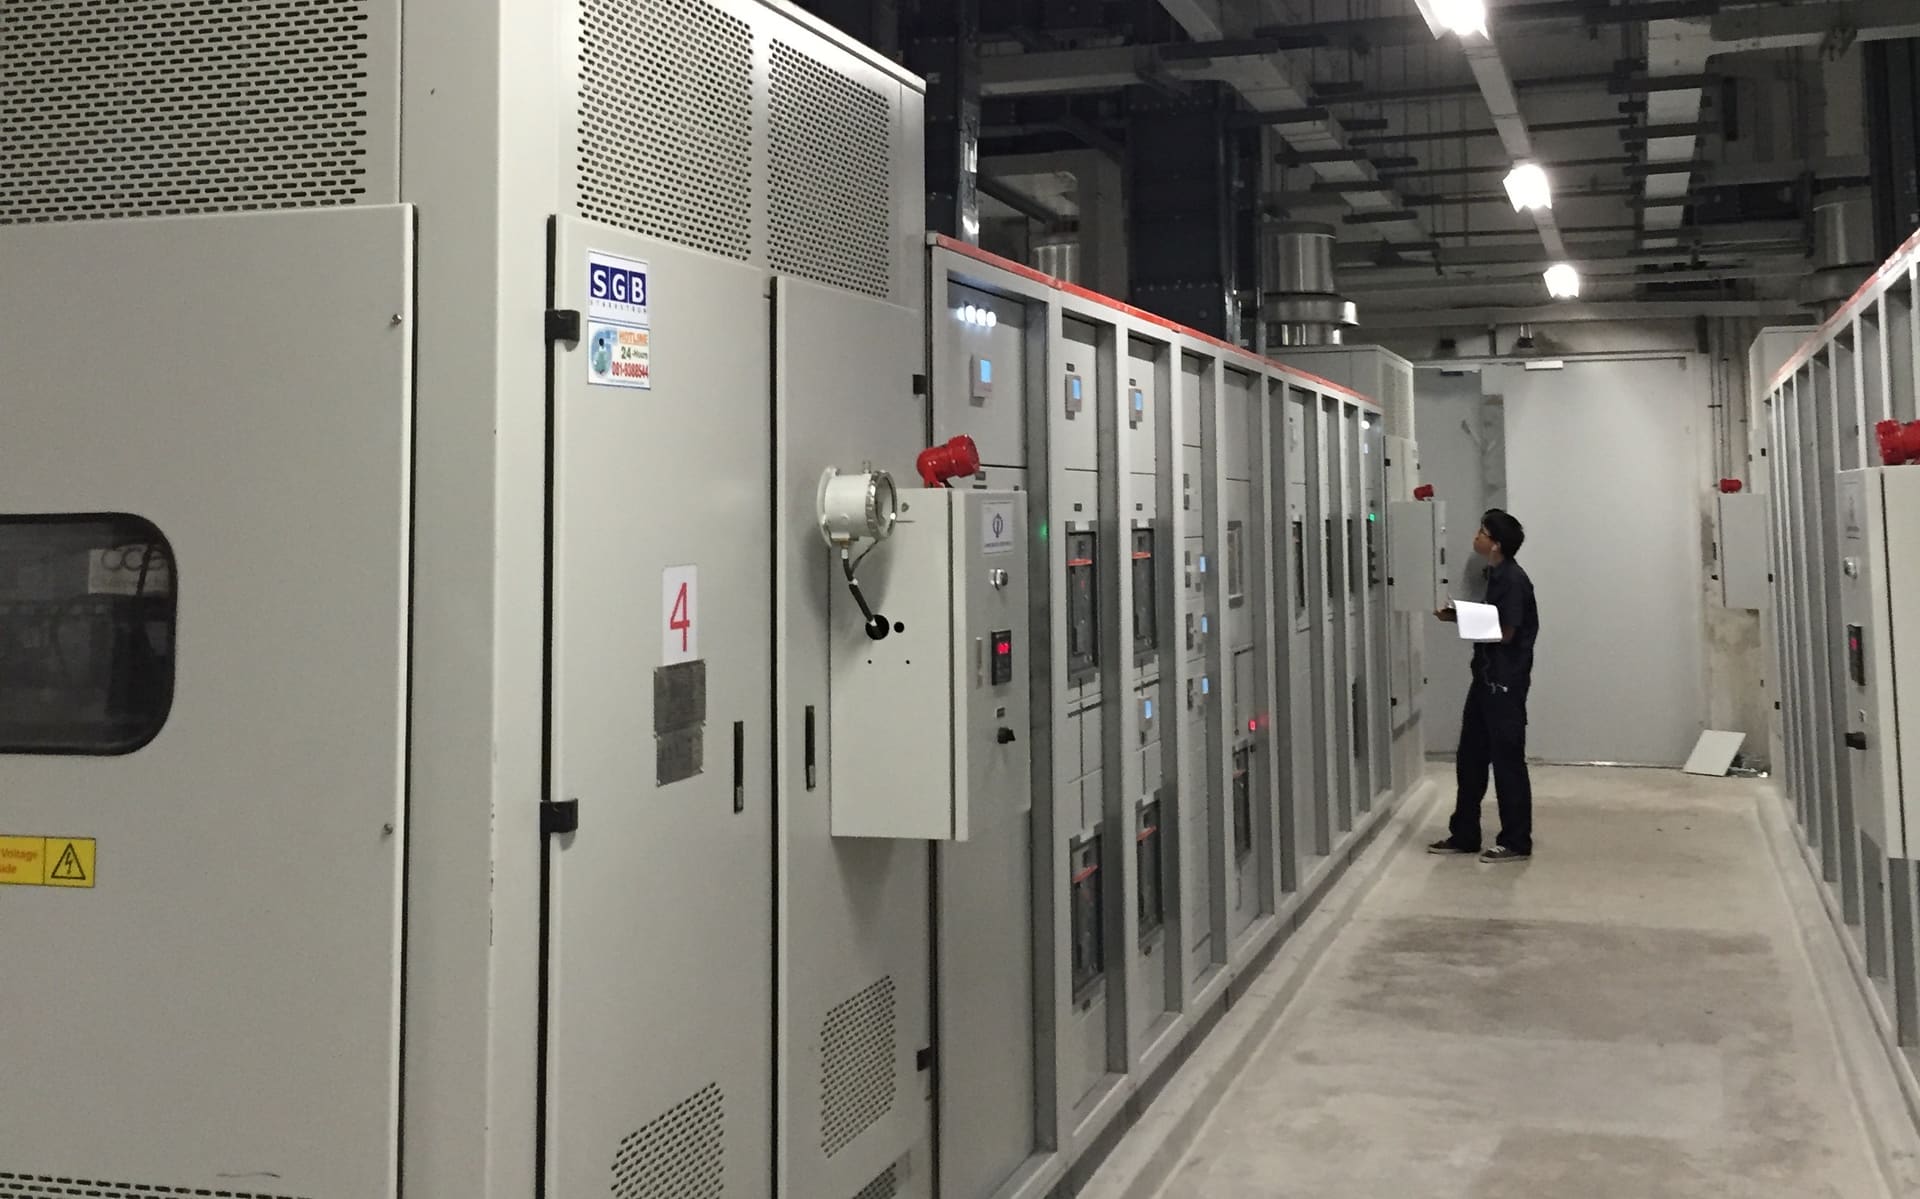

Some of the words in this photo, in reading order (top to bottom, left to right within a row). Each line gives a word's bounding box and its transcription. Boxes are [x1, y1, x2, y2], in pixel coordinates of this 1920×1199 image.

[592, 268, 645, 303] SGB
[670, 582, 691, 653] 4
[1, 847, 38, 862] Voltage
